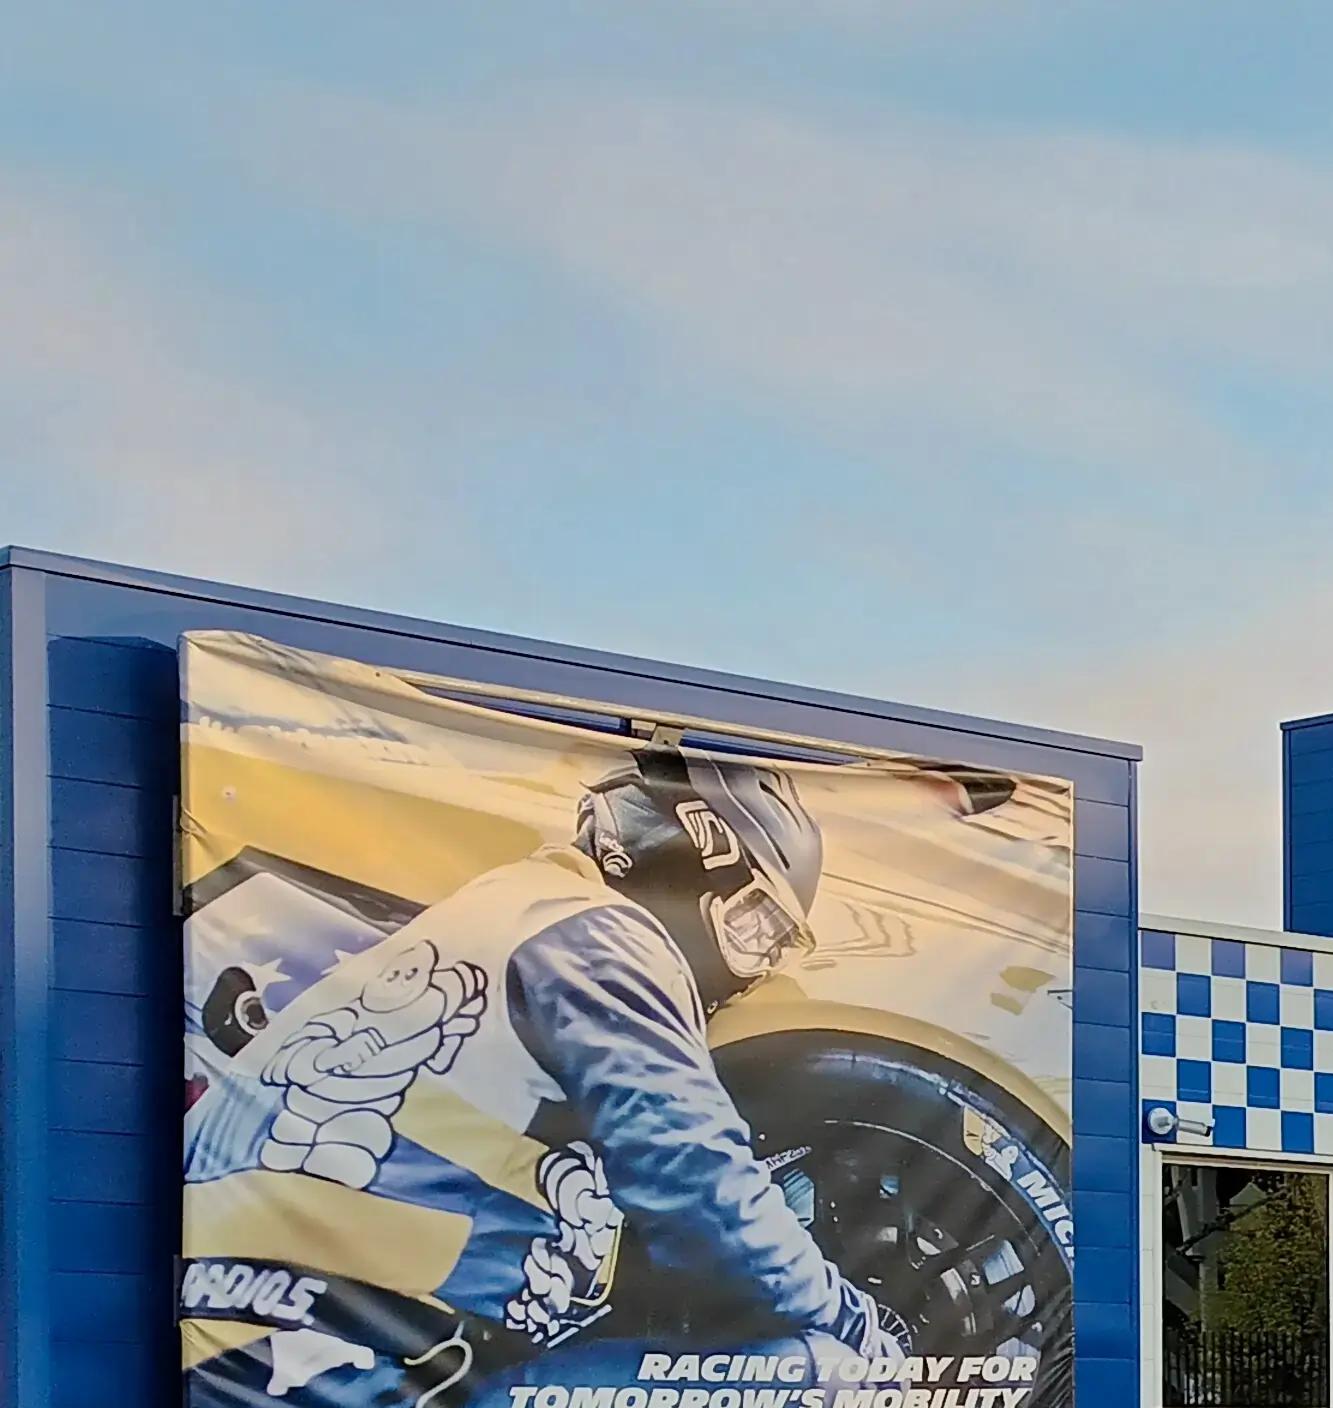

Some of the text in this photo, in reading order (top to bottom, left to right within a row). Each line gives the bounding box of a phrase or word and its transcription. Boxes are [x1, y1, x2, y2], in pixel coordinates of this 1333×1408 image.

[637, 1353, 1037, 1383] RACING TODAY FOR
